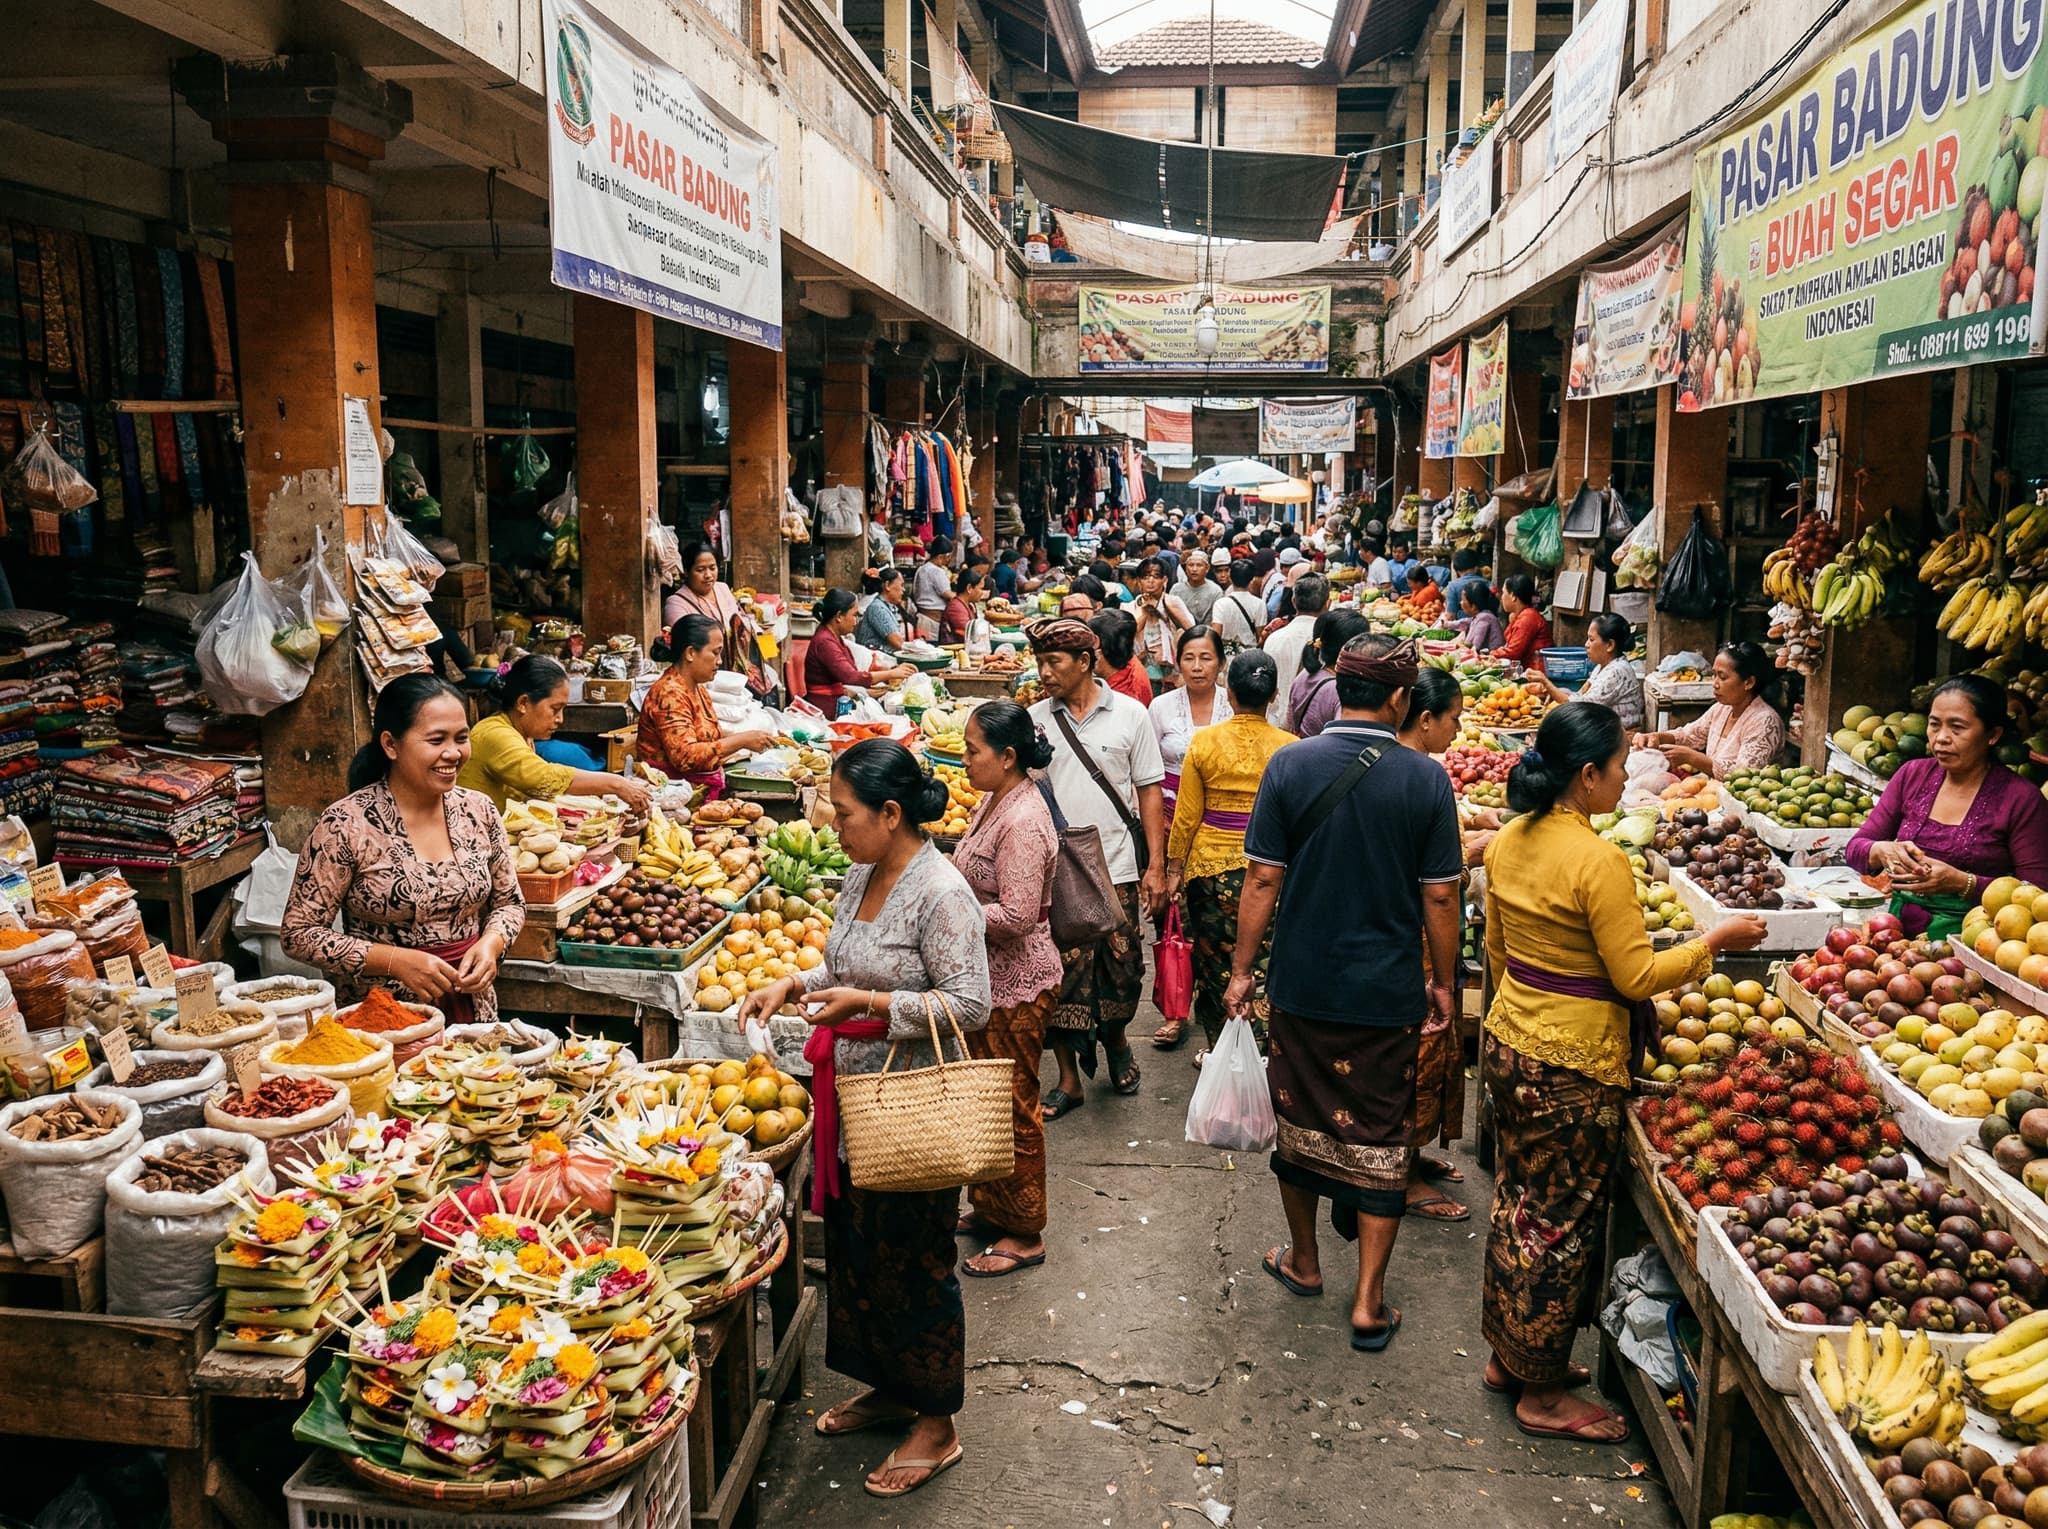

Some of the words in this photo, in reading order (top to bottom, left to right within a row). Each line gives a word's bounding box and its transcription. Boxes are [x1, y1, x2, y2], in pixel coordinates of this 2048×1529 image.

[1719, 91, 1820, 227] PASAR
[1829, 0, 2044, 168] BADUNG
[609, 111, 678, 196] PASAR
[681, 156, 751, 233] BADUNG
[1766, 191, 1836, 276] BUAH
[1844, 135, 1959, 247] SEGAR
[1891, 233, 1946, 278] BLAGAN
[1115, 292, 1183, 305] PASAR
[1214, 291, 1300, 305] BADUNG
[1805, 296, 1875, 340] INDONESAI
